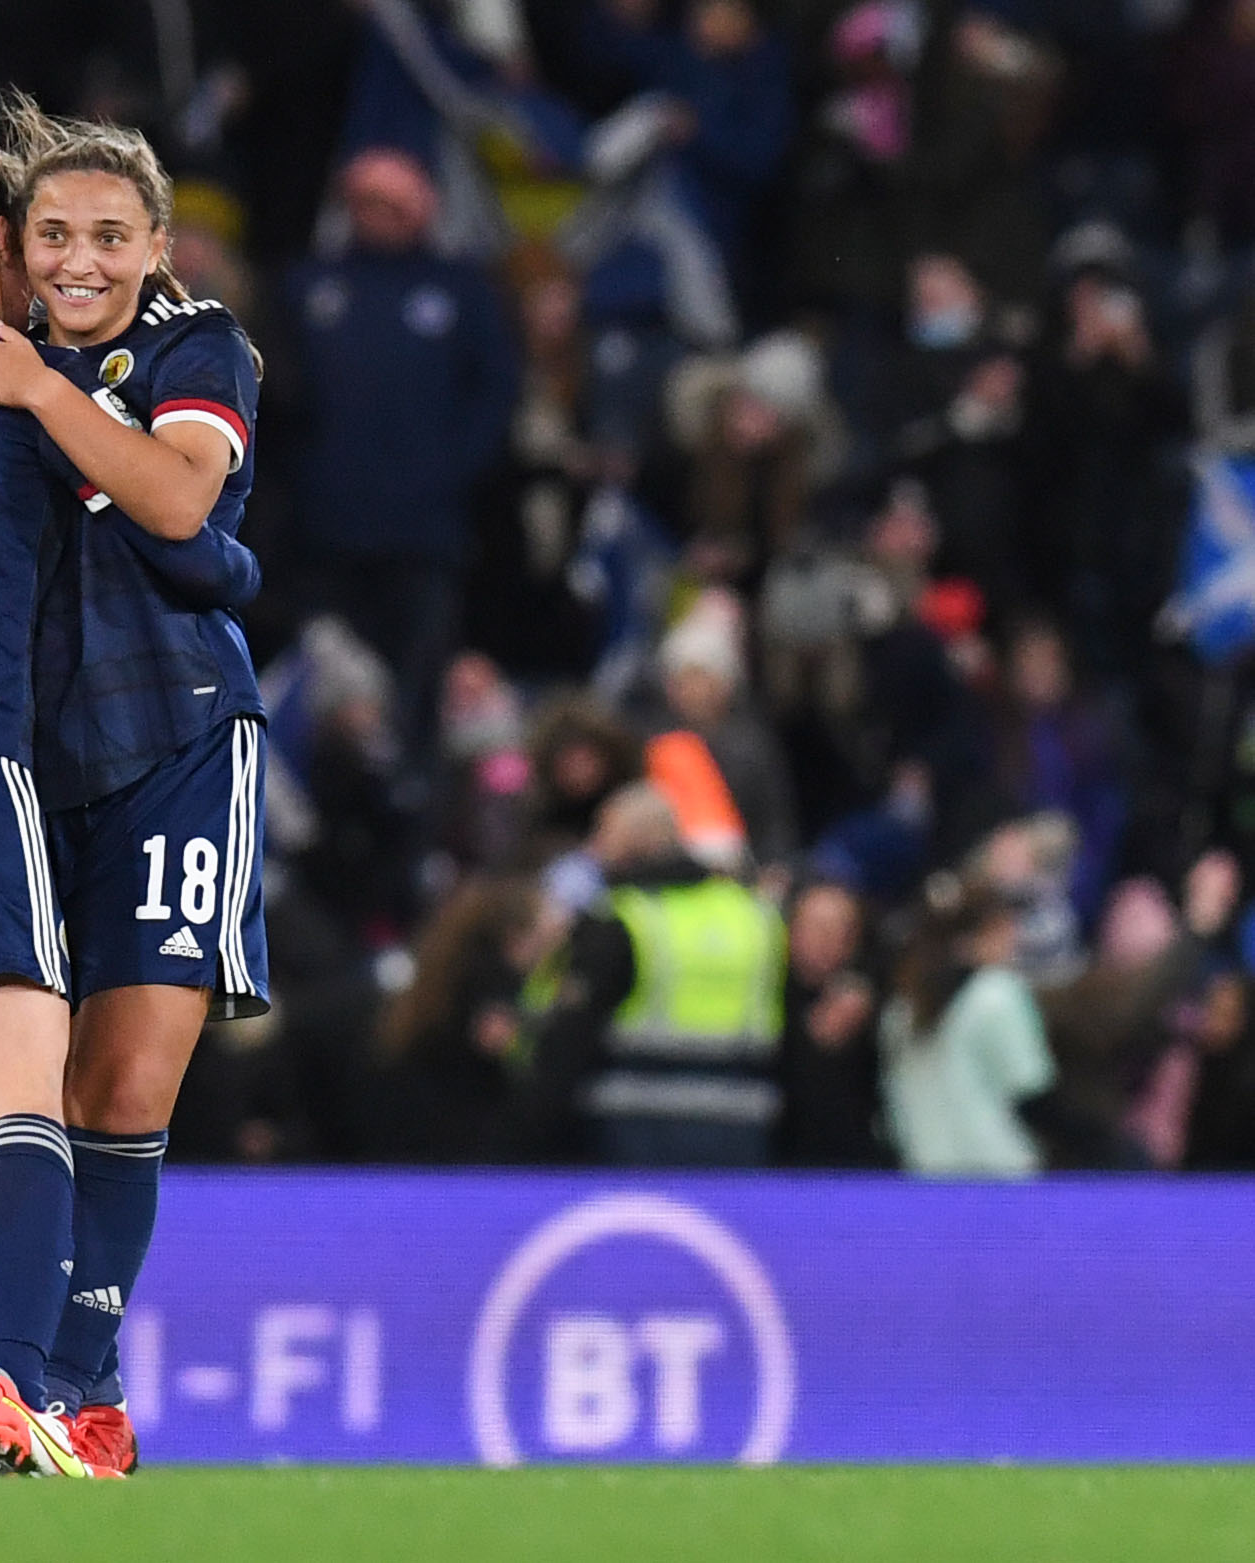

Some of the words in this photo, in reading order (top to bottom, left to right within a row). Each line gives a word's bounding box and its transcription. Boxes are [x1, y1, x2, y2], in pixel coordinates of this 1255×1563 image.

[135, 834, 219, 924] 18
[159, 944, 204, 959] adidas
[72, 1294, 125, 1316] adidas
[543, 1312, 724, 1451] BT
